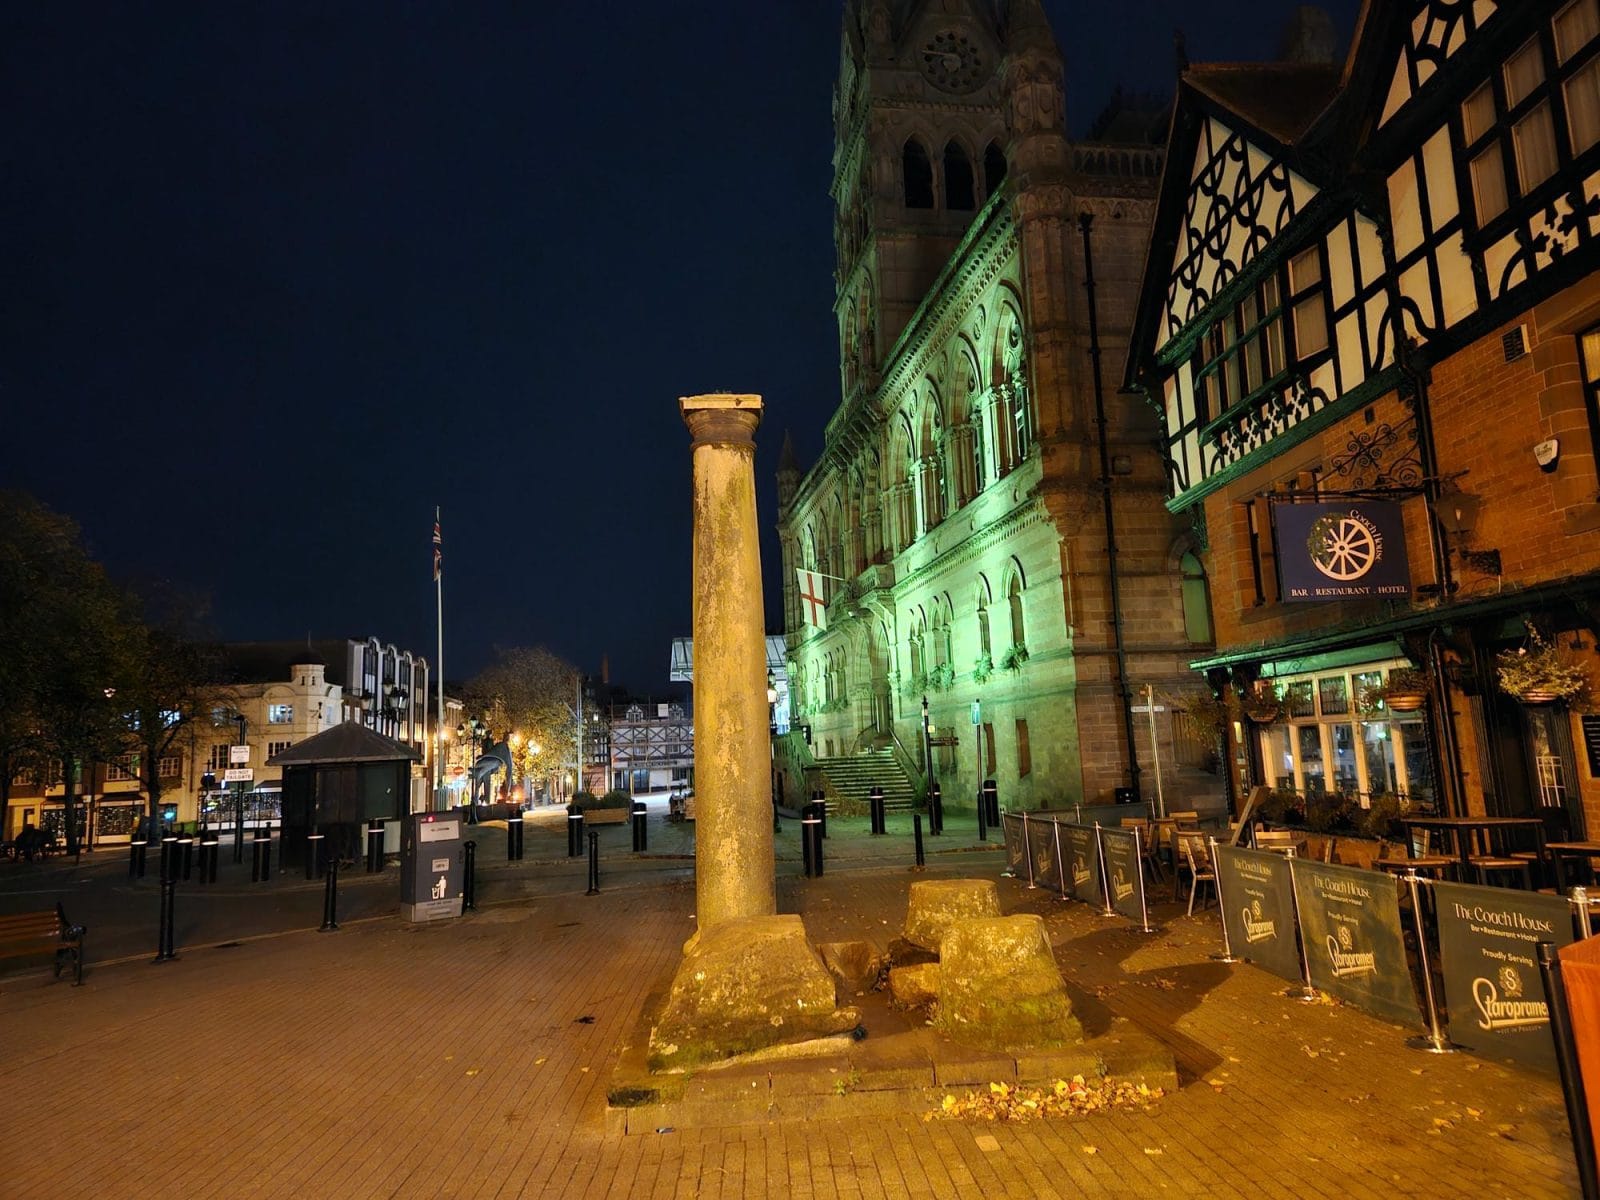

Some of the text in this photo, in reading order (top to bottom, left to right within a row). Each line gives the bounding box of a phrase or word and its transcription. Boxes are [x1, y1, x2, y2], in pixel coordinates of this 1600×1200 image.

[1350, 509, 1384, 561] Coach House
[1291, 585, 1408, 597] BAR RESTAURANT HOTEL
[1242, 859, 1259, 873] Coach
[1259, 863, 1272, 876] House
[1313, 874, 1372, 899] The Coach House
[1452, 902, 1554, 934] The Coach House
[1326, 935, 1377, 977] Staropramen
[1482, 948, 1533, 968] Proudly Serving
[1472, 977, 1550, 1030] Staroprame
